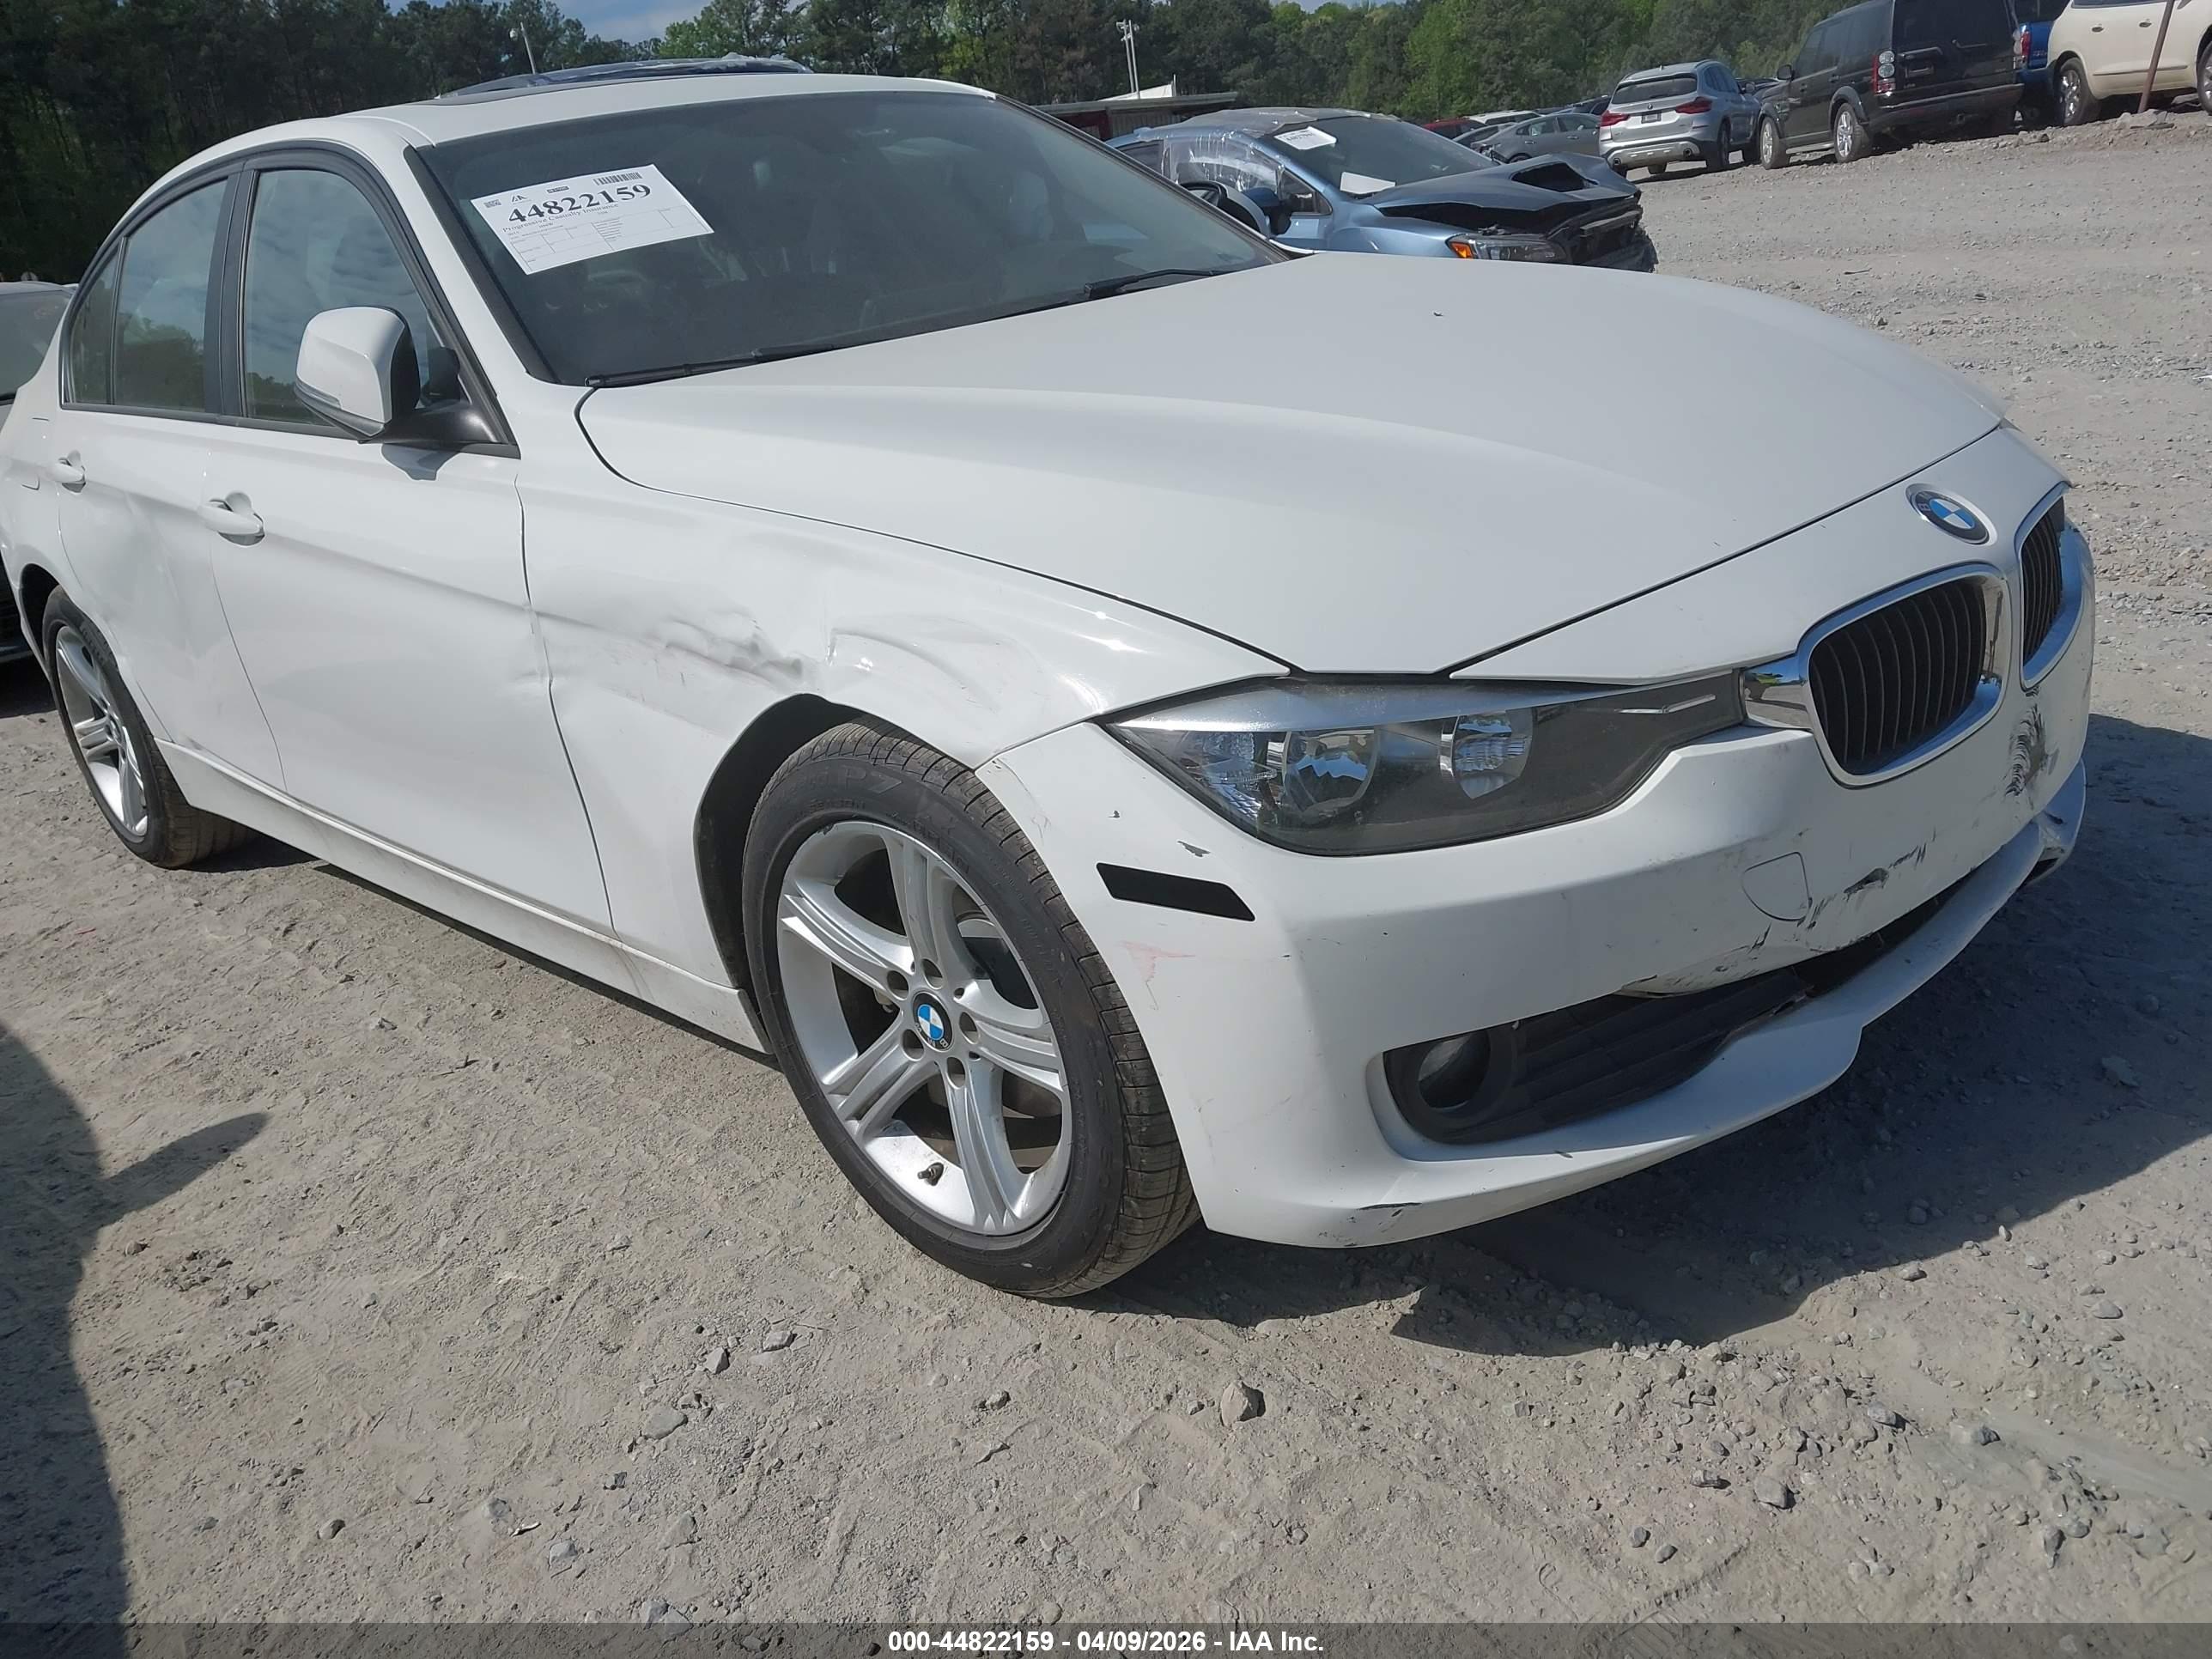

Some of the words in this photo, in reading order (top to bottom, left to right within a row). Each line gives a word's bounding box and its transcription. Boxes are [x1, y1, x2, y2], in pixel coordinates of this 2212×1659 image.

[502, 217, 548, 233] Progressive
[548, 210, 581, 222] Casualty
[582, 204, 619, 214] Insurance
[508, 184, 651, 223] 44822159
